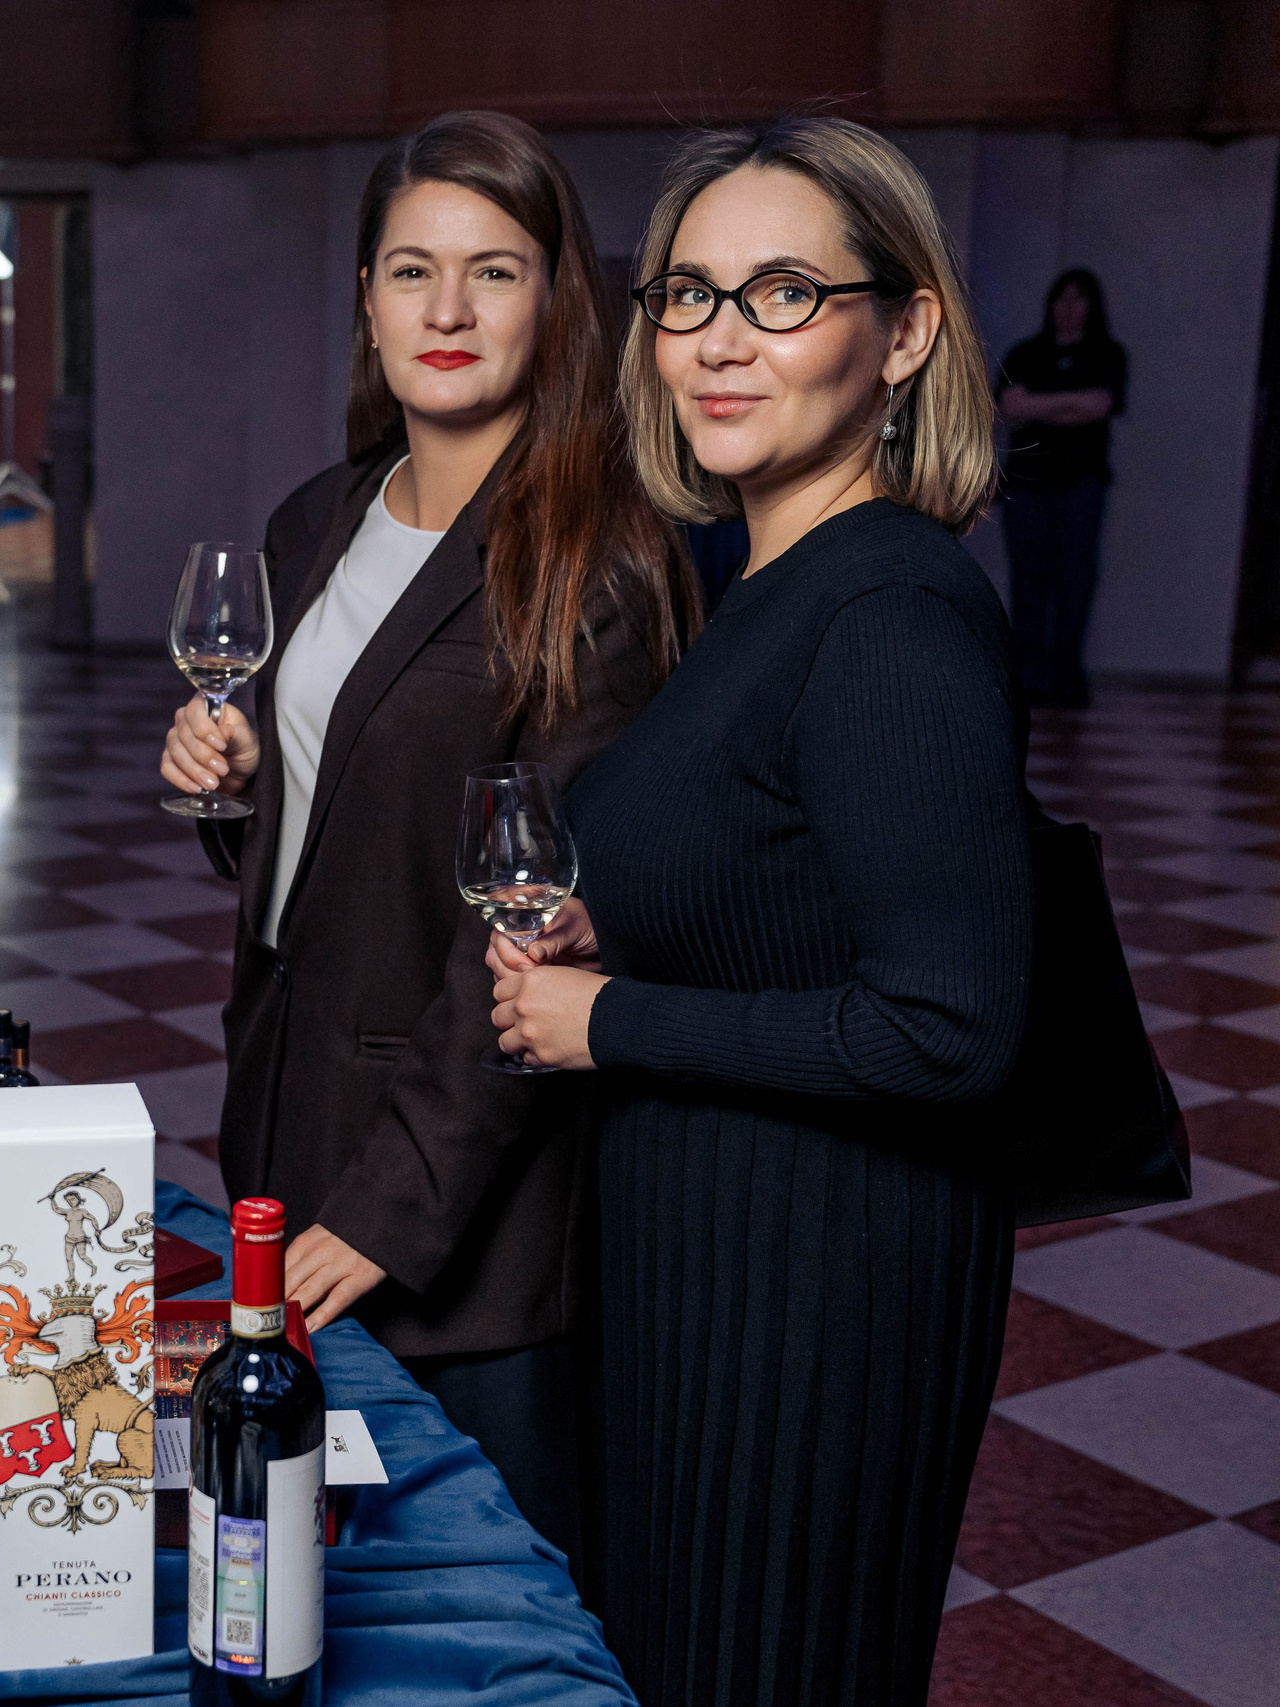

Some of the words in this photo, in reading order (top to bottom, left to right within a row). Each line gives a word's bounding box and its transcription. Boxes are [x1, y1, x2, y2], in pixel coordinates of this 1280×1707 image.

[53, 1560, 96, 1568] TENUTA
[16, 1570, 132, 1587] PERANO
[26, 1592, 67, 1601] CHIANTI
[71, 1590, 122, 1599] CLASSICO
